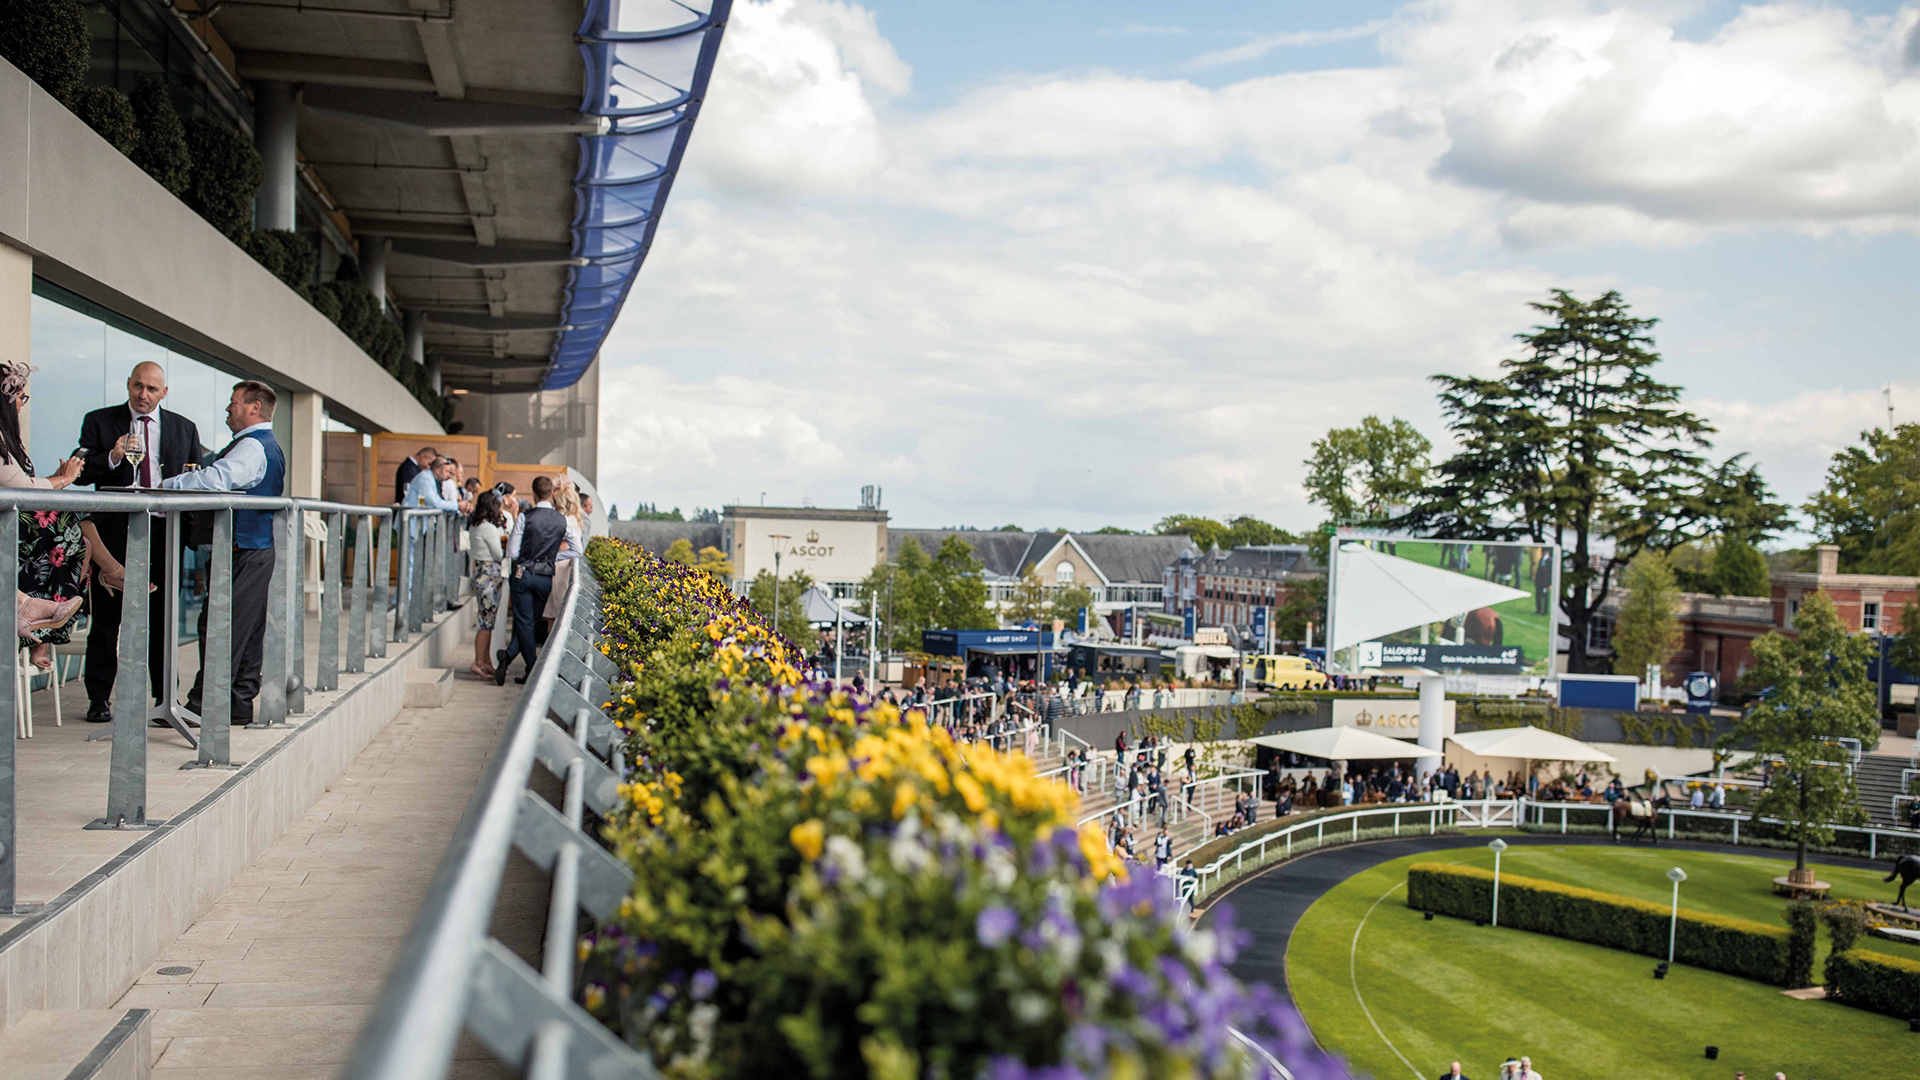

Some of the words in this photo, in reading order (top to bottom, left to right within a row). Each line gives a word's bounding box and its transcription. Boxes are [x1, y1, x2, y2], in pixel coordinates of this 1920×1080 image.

[789, 546, 834, 557] ASCOT
[1011, 635, 1028, 643] SHOP
[1367, 651, 1374, 661] 3
[1376, 713, 1420, 727] ASCO
